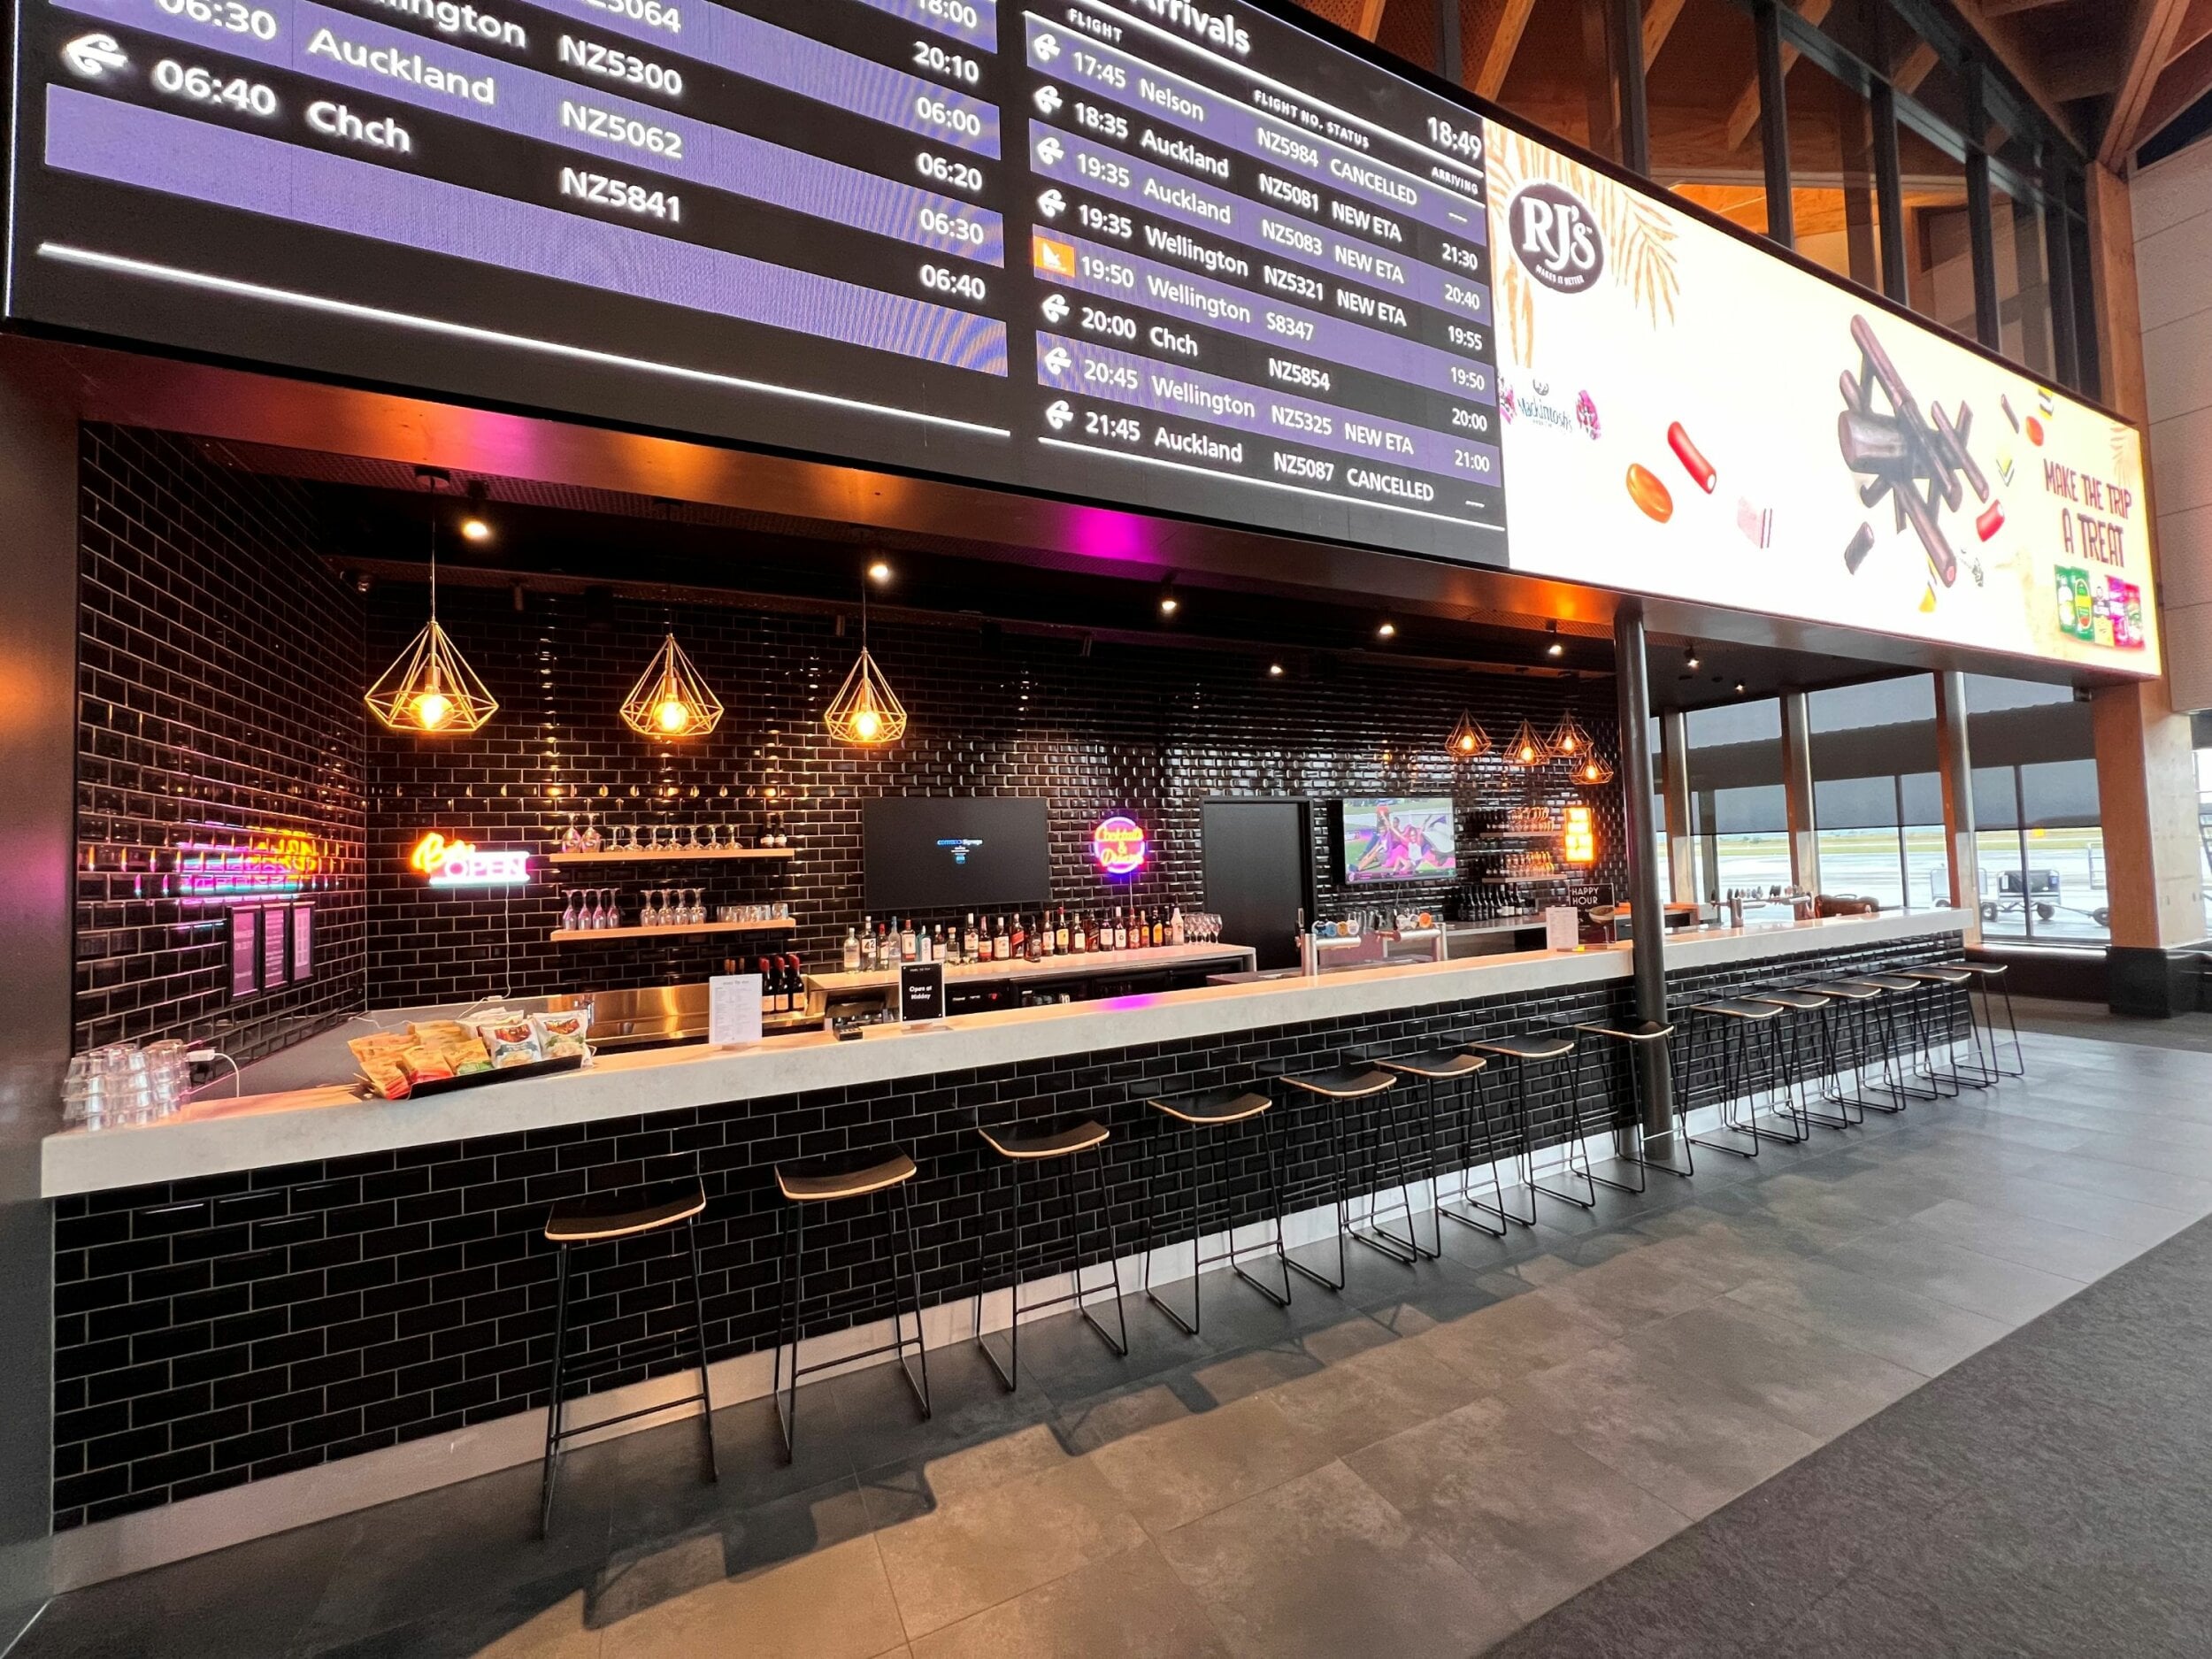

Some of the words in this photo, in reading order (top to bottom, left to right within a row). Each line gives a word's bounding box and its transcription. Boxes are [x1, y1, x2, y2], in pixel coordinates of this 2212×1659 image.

[1069, 8, 1122, 42] FLIGHT
[1131, 0, 1251, 53] rrivals
[914, 41, 979, 82] 20:10
[307, 27, 497, 105] Auckland
[561, 101, 682, 159] NZ5062
[919, 208, 985, 245] 06:30
[562, 35, 682, 95] NZ5300
[918, 152, 982, 190] 06:20
[917, 96, 981, 136] 06:00
[1073, 51, 1126, 88] 17:45
[1140, 78, 1204, 122] Nelson
[1257, 127, 1319, 167] NZ5984
[1330, 158, 1417, 205] CANCELLED
[1255, 89, 1298, 118] FLIGHT
[1327, 121, 1369, 148] STATUS
[1427, 117, 1482, 159] 18:49
[156, 59, 276, 115] 06:40
[308, 101, 410, 151] Chch
[563, 167, 680, 222] NZ5841
[921, 264, 986, 300] 06:40
[1075, 102, 1128, 138] 18:35
[1141, 129, 1229, 178] Auckland
[1259, 173, 1318, 211] NZ5081
[1332, 201, 1371, 230] NEW
[1372, 216, 1402, 242] ETA
[1442, 242, 1479, 270] 21:30
[1432, 166, 1479, 195] ARRIVING
[1078, 153, 1130, 188] 19:35
[1143, 178, 1231, 225] Auckland
[1262, 219, 1323, 256] NZ5083
[1334, 244, 1373, 273] NEW
[1375, 258, 1404, 284] ETA
[1444, 283, 1480, 311] 20:40
[1519, 196, 1595, 271] RJ's
[1079, 204, 1133, 238] 19:35
[1145, 225, 1248, 277] Wellington
[1263, 265, 1323, 301] NZ5321
[1337, 288, 1375, 316] NEW
[1378, 302, 1407, 326] ETA
[1448, 325, 1483, 350] 19:55
[1081, 256, 1134, 288] 19:50
[1147, 274, 1250, 323] Wellington
[1266, 311, 1314, 341] S8347
[1450, 366, 1486, 391] 19:50
[1081, 307, 1136, 339] 20:00
[1150, 326, 1198, 357] Chch
[1269, 357, 1331, 391] NZ5854
[1452, 407, 1487, 432] 20:00
[1084, 359, 1139, 390] 20:45
[1151, 375, 1256, 419] Wellington
[1271, 404, 1333, 435] NZ5325
[1344, 422, 1382, 448] NEW
[1385, 432, 1415, 455] ETA
[1455, 449, 1490, 472] 21:00
[1086, 411, 1141, 442] 21:45
[1155, 426, 1242, 463] Auckland
[1273, 451, 1334, 481] NZ5087
[1347, 468, 1434, 502] CANCELLED
[2043, 458, 2078, 503] MAKE
[2081, 473, 2104, 511] THE
[2107, 483, 2132, 519] TRIP
[2062, 508, 2074, 554] A
[2078, 512, 2124, 567] TREAT
[444, 855, 521, 879] OPEN
[1571, 887, 1599, 895] HAPPY
[1572, 896, 1598, 905] HOUR
[864, 940, 875, 949] 42
